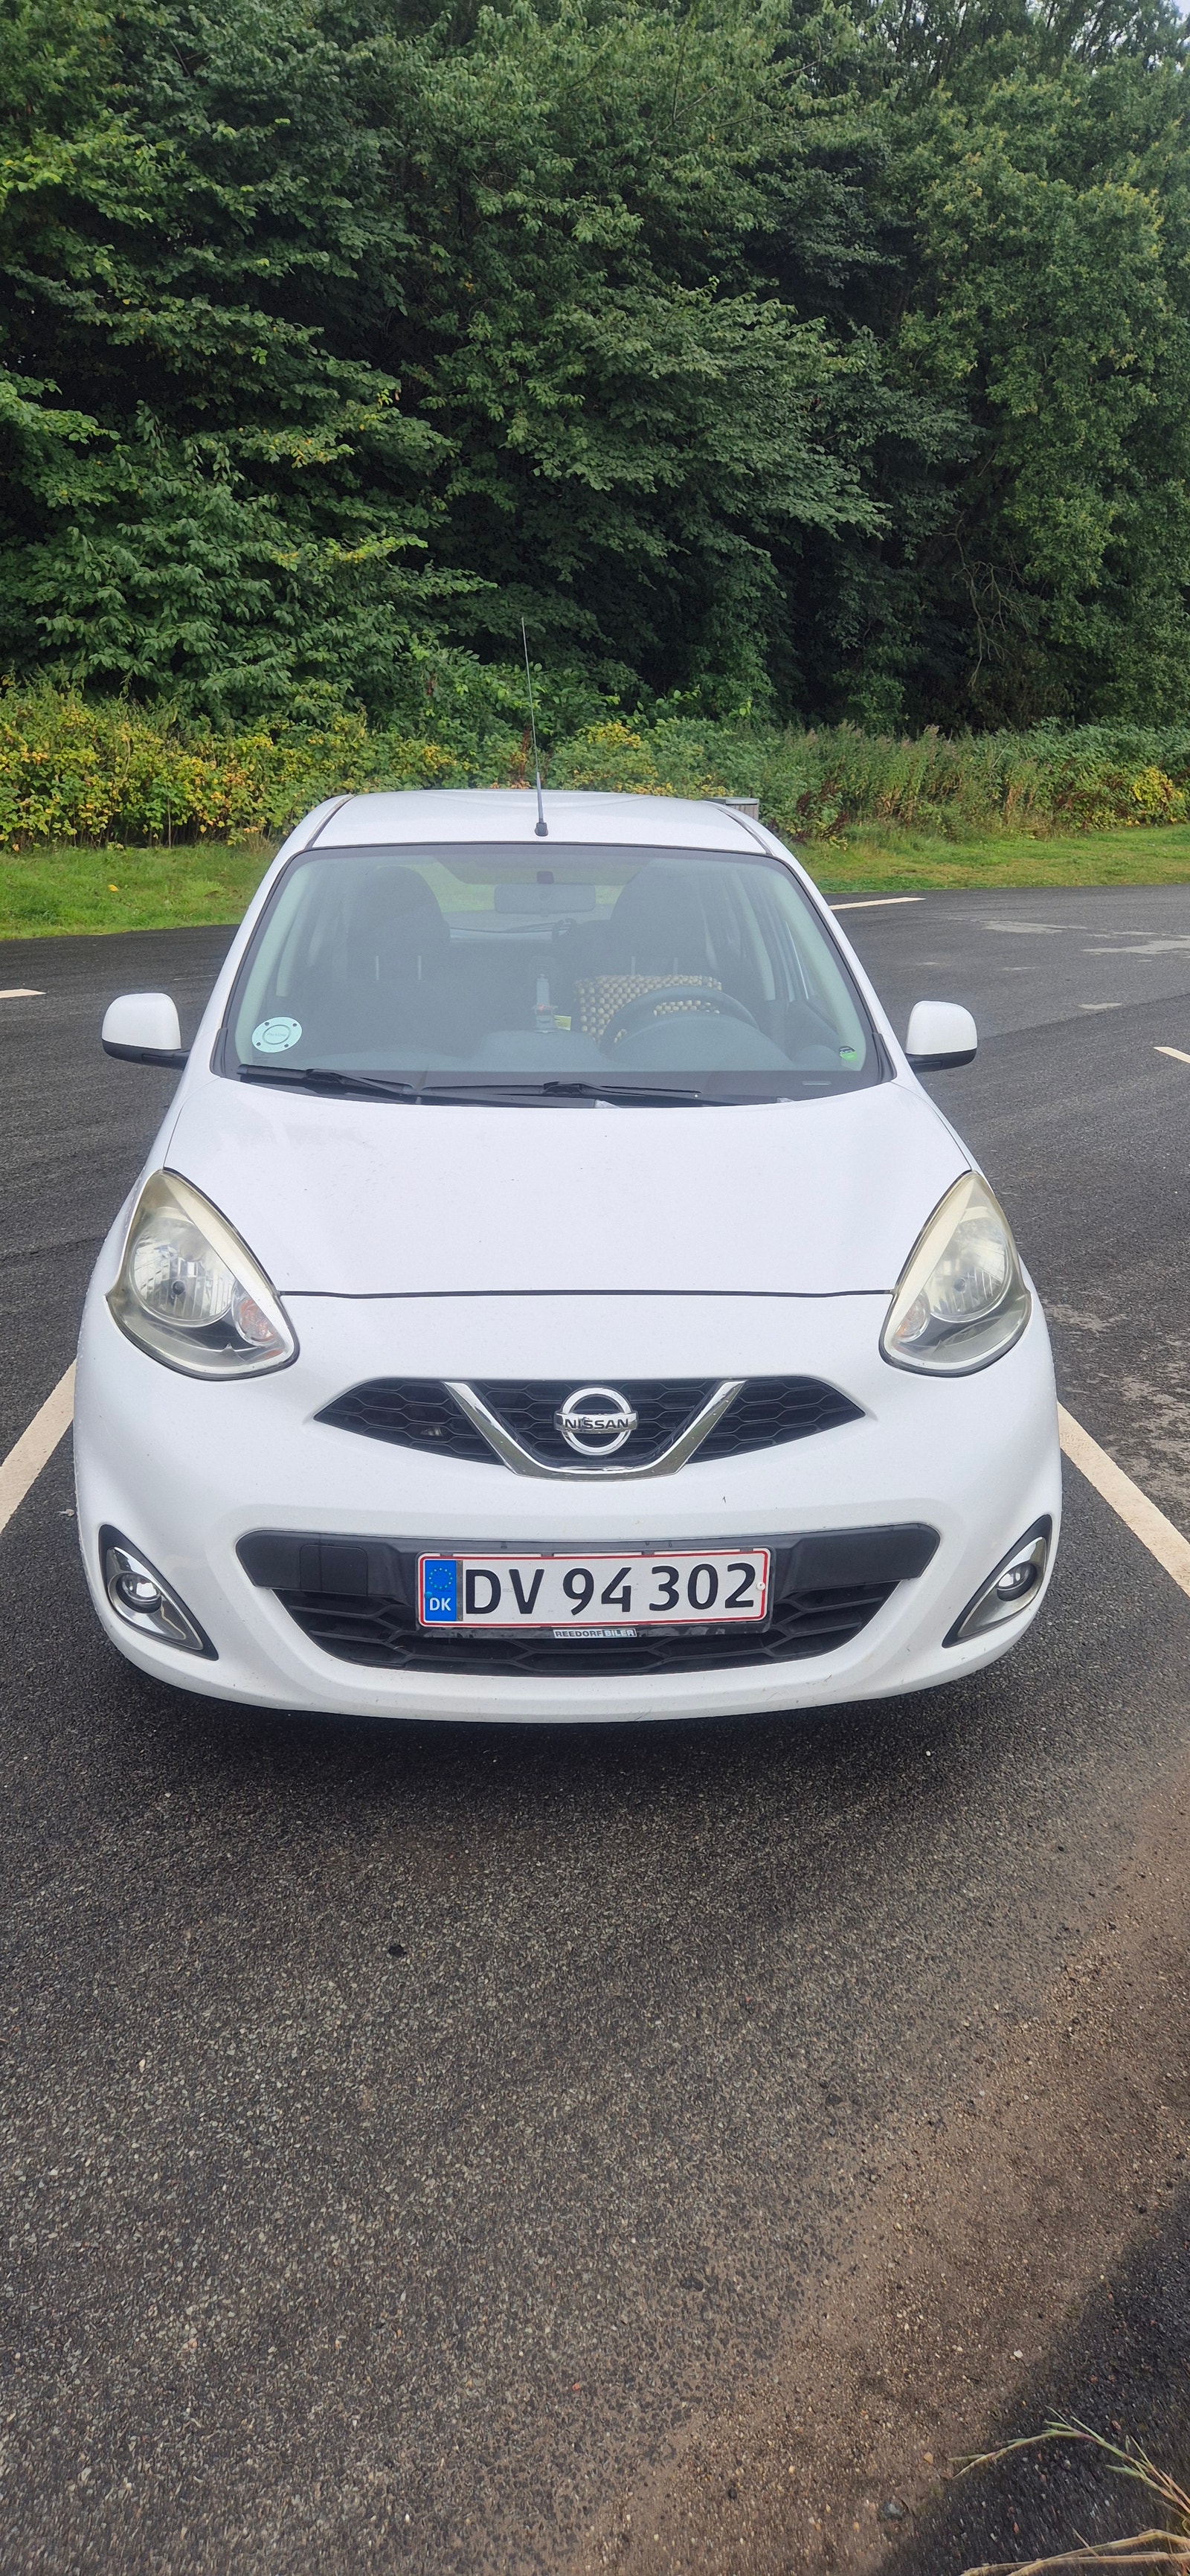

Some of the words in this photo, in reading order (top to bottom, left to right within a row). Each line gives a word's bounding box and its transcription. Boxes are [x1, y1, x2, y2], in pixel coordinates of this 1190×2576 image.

[565, 1418, 628, 1430] NISSAN
[465, 1568, 544, 1615] DV
[562, 1567, 632, 1616] 94
[649, 1562, 756, 1612] 302
[429, 1597, 451, 1611] DK
[603, 1629, 634, 1637] BILER
